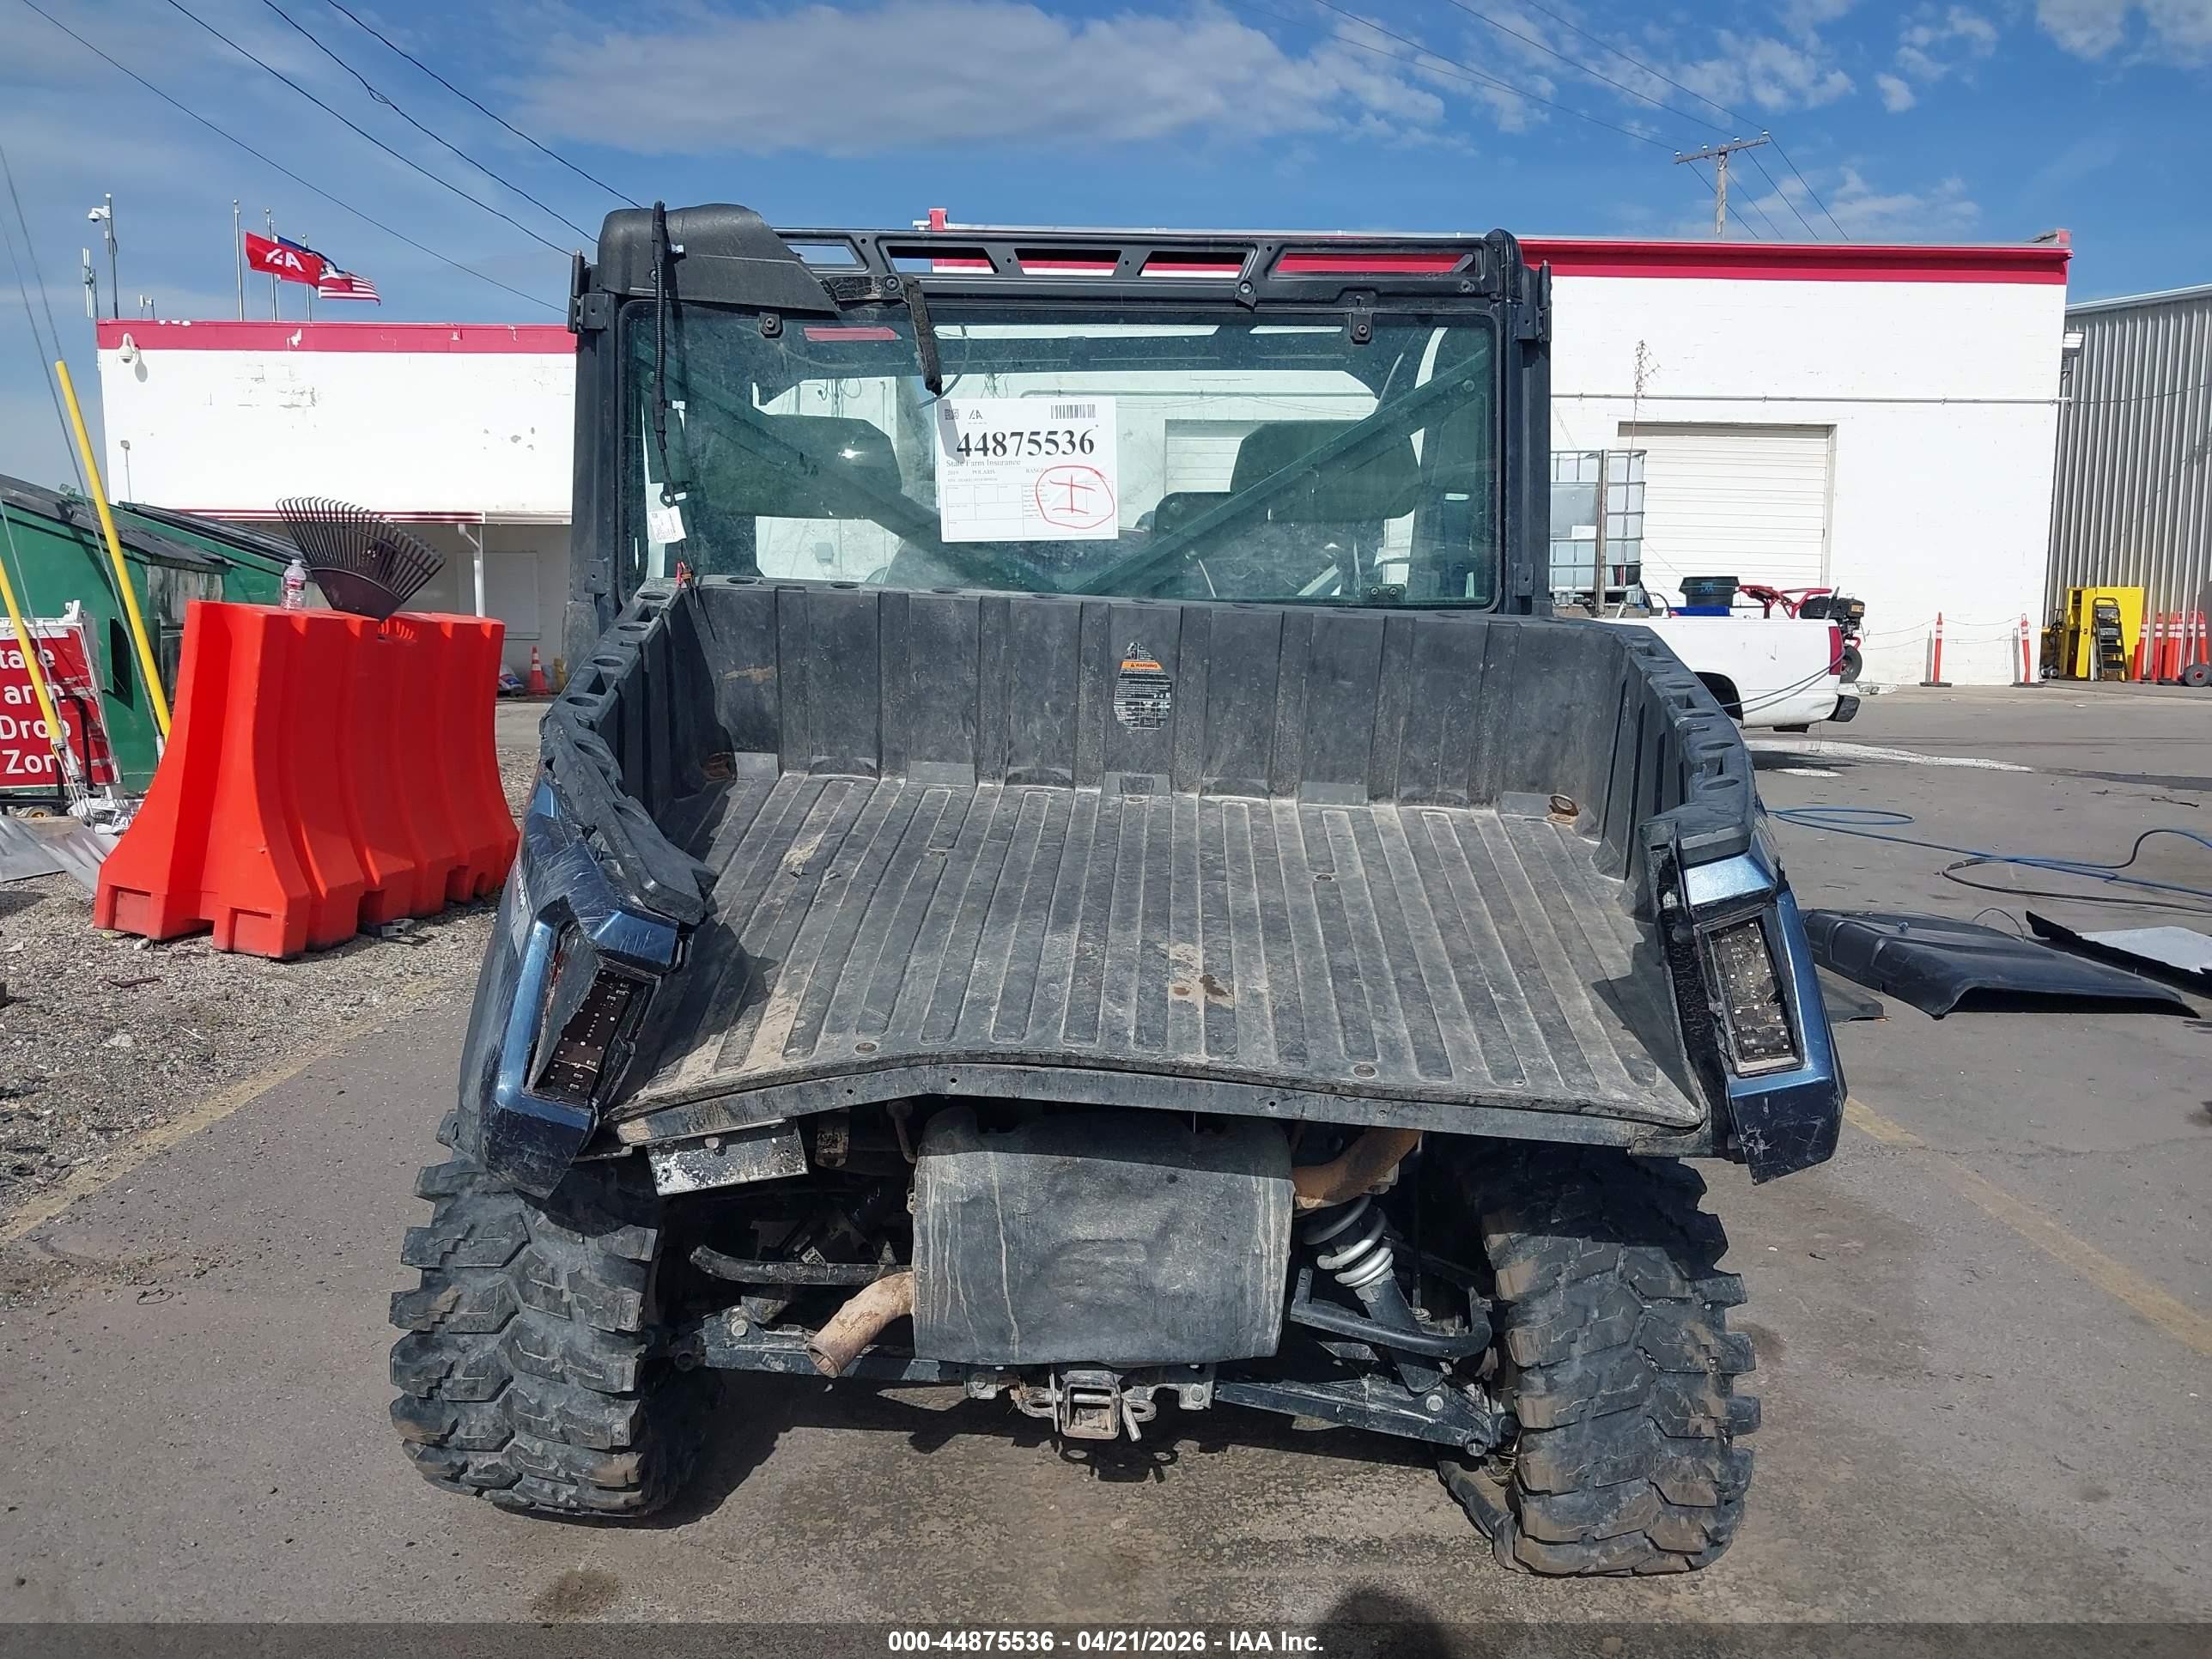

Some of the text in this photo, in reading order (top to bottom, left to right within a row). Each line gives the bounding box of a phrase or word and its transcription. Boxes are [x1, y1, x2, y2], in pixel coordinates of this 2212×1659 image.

[956, 428, 1095, 458] 44875536
[946, 459, 964, 468] State
[987, 459, 1021, 467] Insurance
[0, 647, 55, 669] tae
